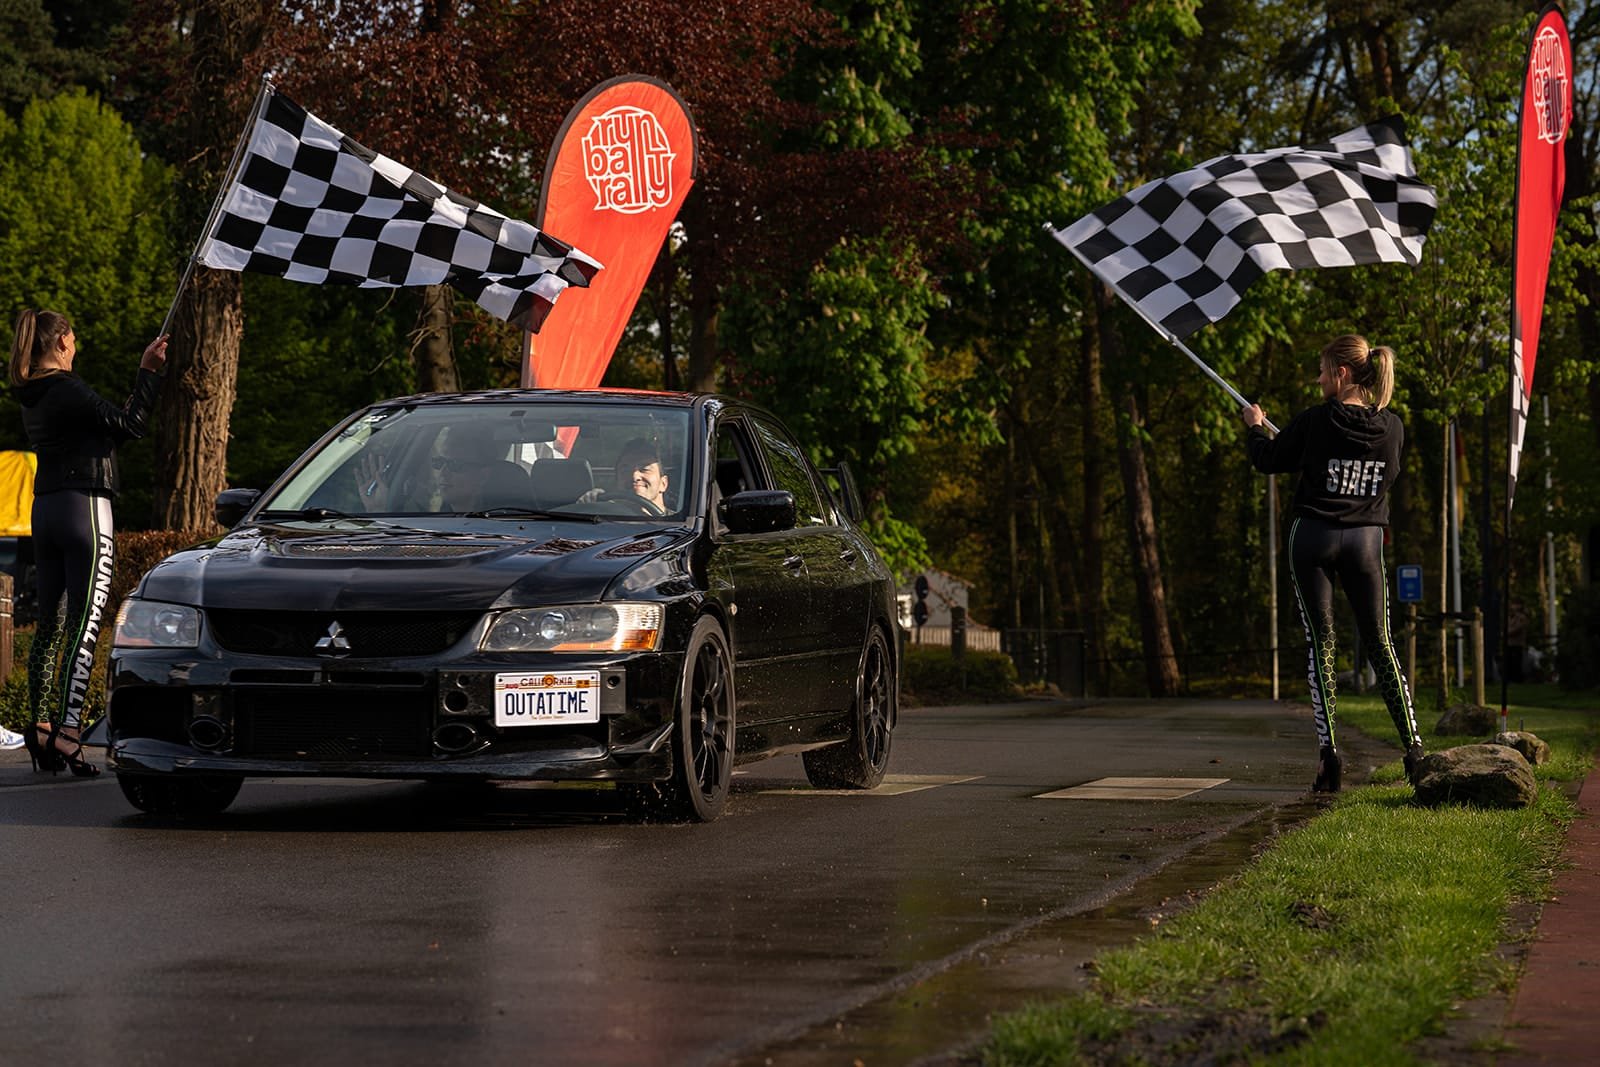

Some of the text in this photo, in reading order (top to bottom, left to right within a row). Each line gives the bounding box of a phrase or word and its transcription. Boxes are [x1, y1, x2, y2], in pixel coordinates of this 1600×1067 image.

[591, 111, 667, 152] run
[1326, 458, 1386, 496] STAFF
[65, 535, 114, 722] RUNBALL RALLY
[520, 676, 574, 688] CALIFORNIA
[505, 690, 589, 716] OUTATIME
